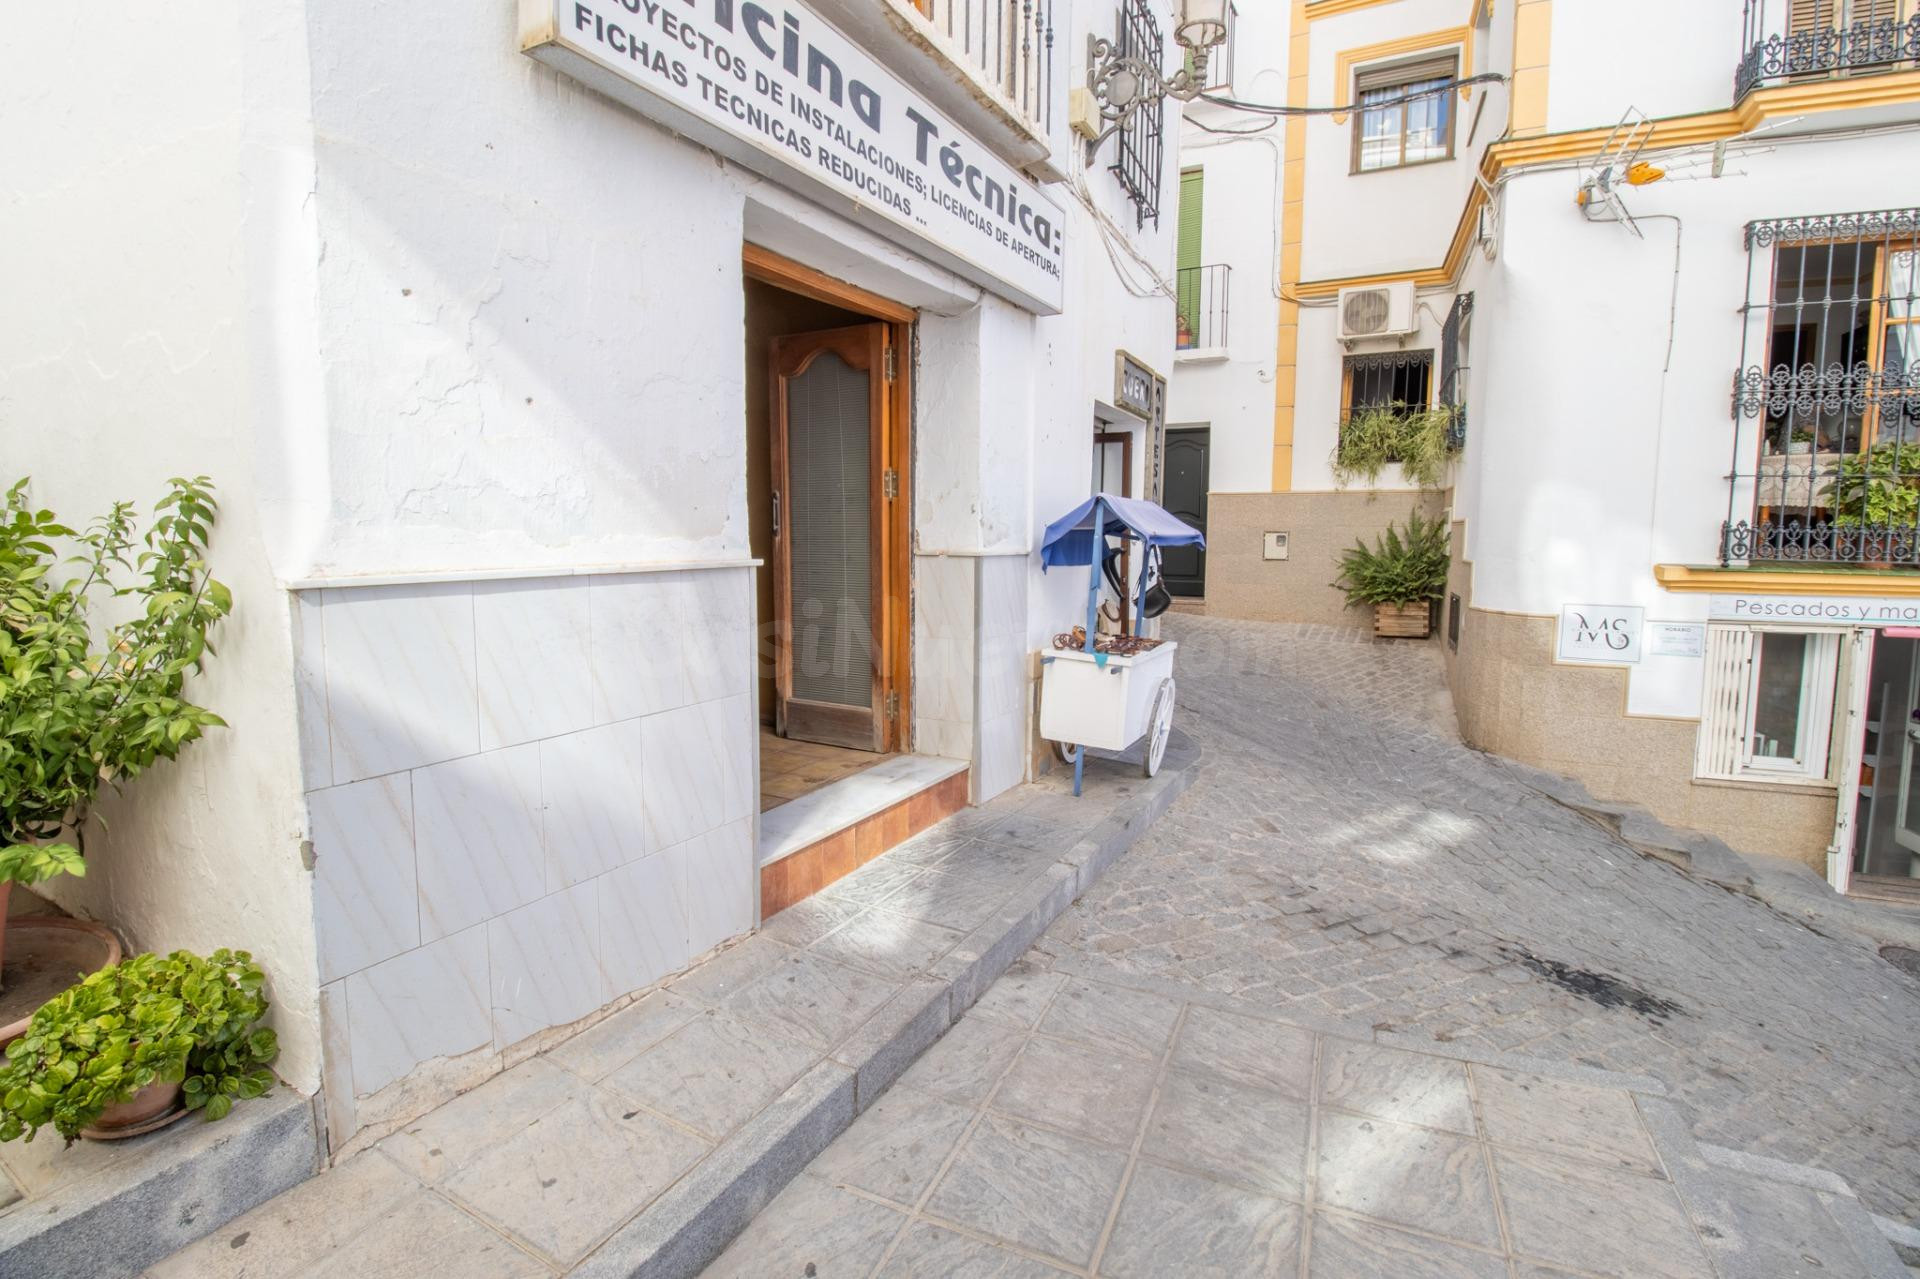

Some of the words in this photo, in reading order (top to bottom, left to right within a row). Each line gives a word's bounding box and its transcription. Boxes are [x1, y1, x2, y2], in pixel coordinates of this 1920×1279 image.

[575, 2, 688, 88] FICHAS
[697, 73, 812, 158] TECNICAS
[818, 146, 911, 217] REDUCIDAS
[756, 70, 783, 107] DE
[791, 93, 927, 200] INSTALACIONES;
[931, 185, 993, 237] LICENCIAS
[996, 227, 1009, 247] DE
[906, 106, 1061, 256] Técnica:
[1735, 599, 1850, 617] Pescados
[1858, 606, 1871, 621] y
